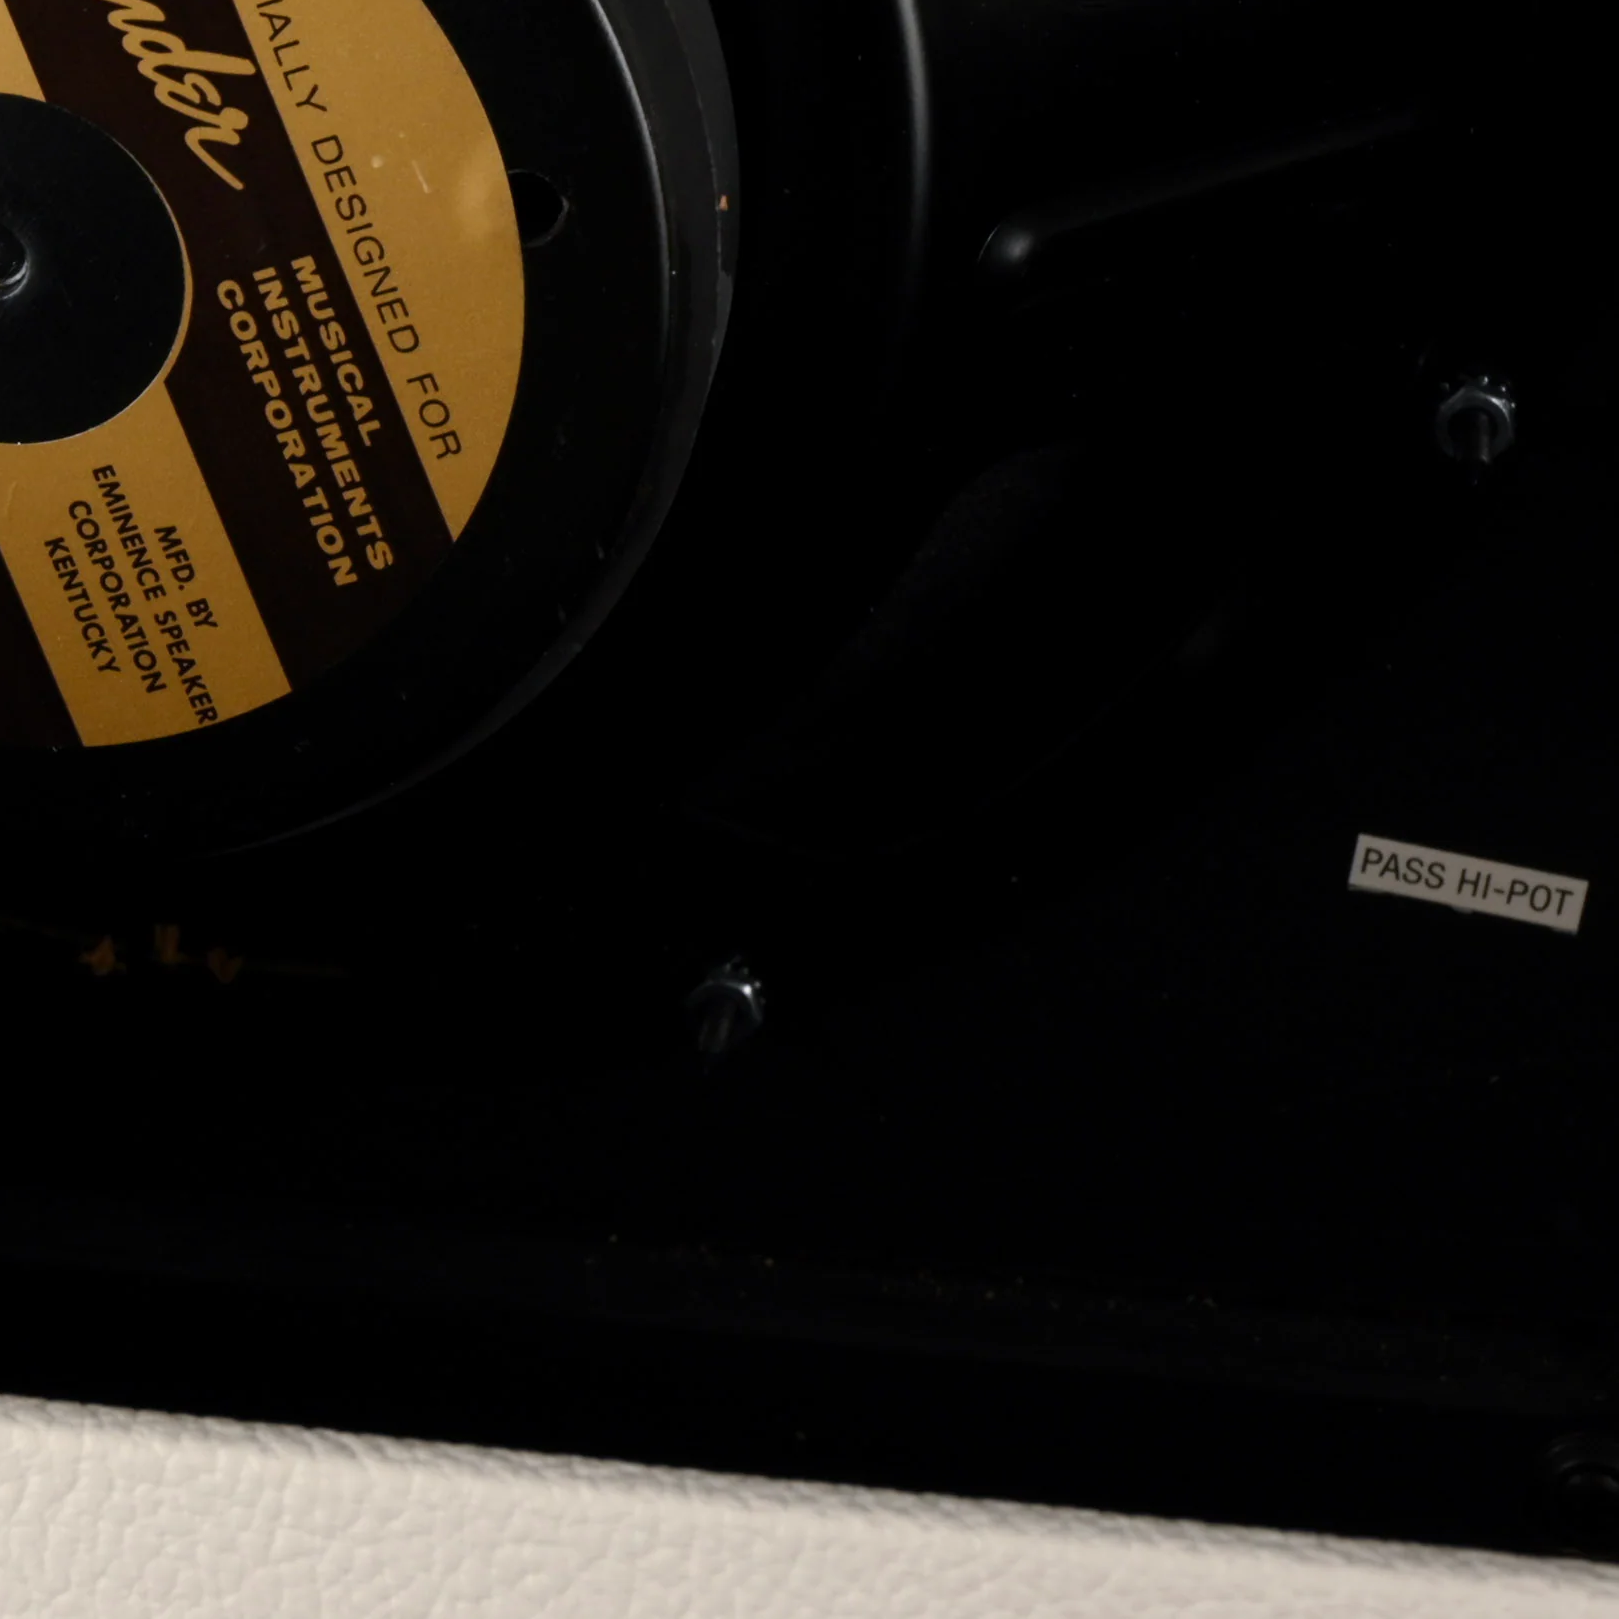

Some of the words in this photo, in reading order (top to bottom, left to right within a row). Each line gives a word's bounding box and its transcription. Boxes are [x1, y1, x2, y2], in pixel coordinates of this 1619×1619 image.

[290, 254, 382, 448] MUSICAL
[310, 134, 420, 354] DESIGNED
[406, 372, 462, 460] FOR
[216, 278, 359, 587] CORPORATION
[252, 266, 395, 572] INSTRUMENTS
[43, 536, 122, 674] KENTUCKY
[68, 500, 168, 694] CORPORATION
[92, 464, 167, 602] EMINENCE
[153, 610, 219, 725] SPEAKER
[153, 525, 196, 591] MFD.
[185, 597, 219, 629] BY
[1360, 846, 1446, 890] PASS
[1457, 868, 1574, 916] HI-POT
